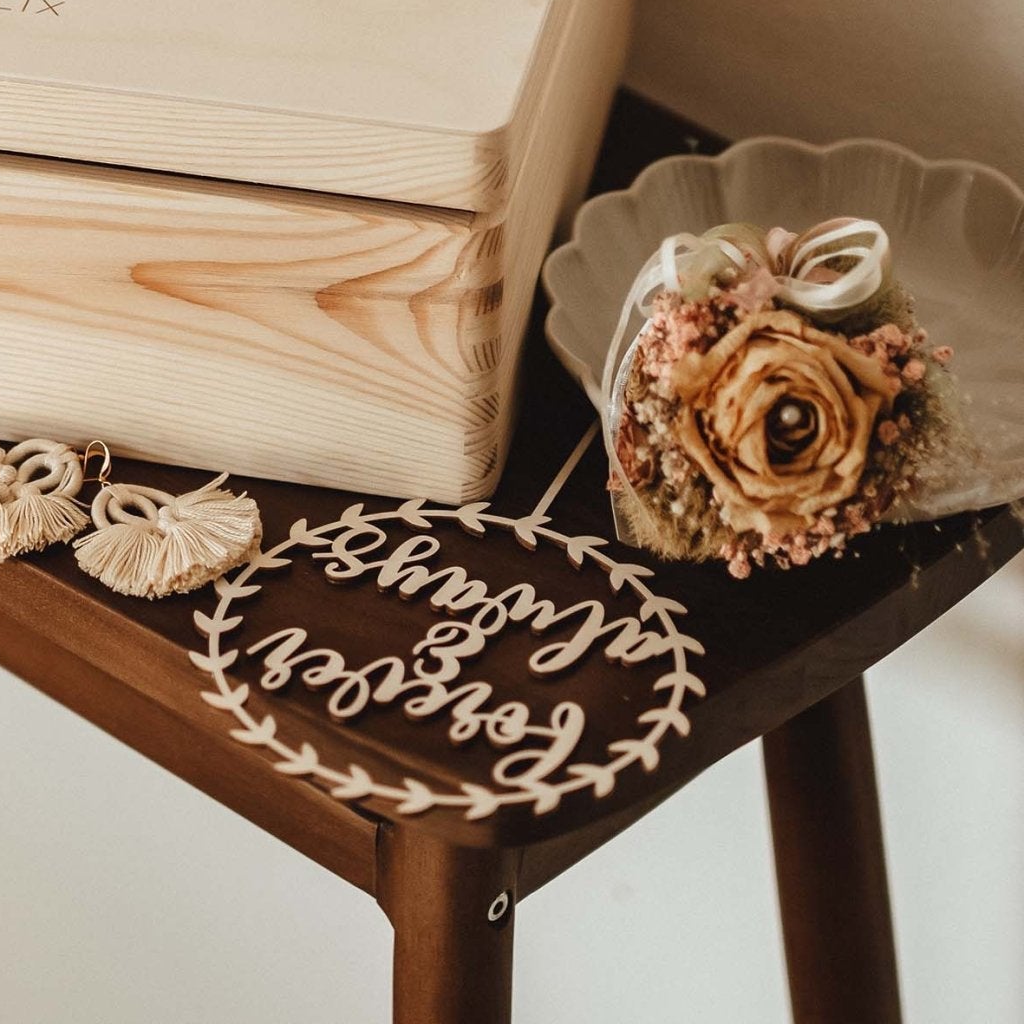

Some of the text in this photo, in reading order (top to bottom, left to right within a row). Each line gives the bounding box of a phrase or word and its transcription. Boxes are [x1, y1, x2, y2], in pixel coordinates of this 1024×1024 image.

[312, 524, 674, 674] always
[412, 620, 486, 683] &
[246, 627, 585, 789] forever
